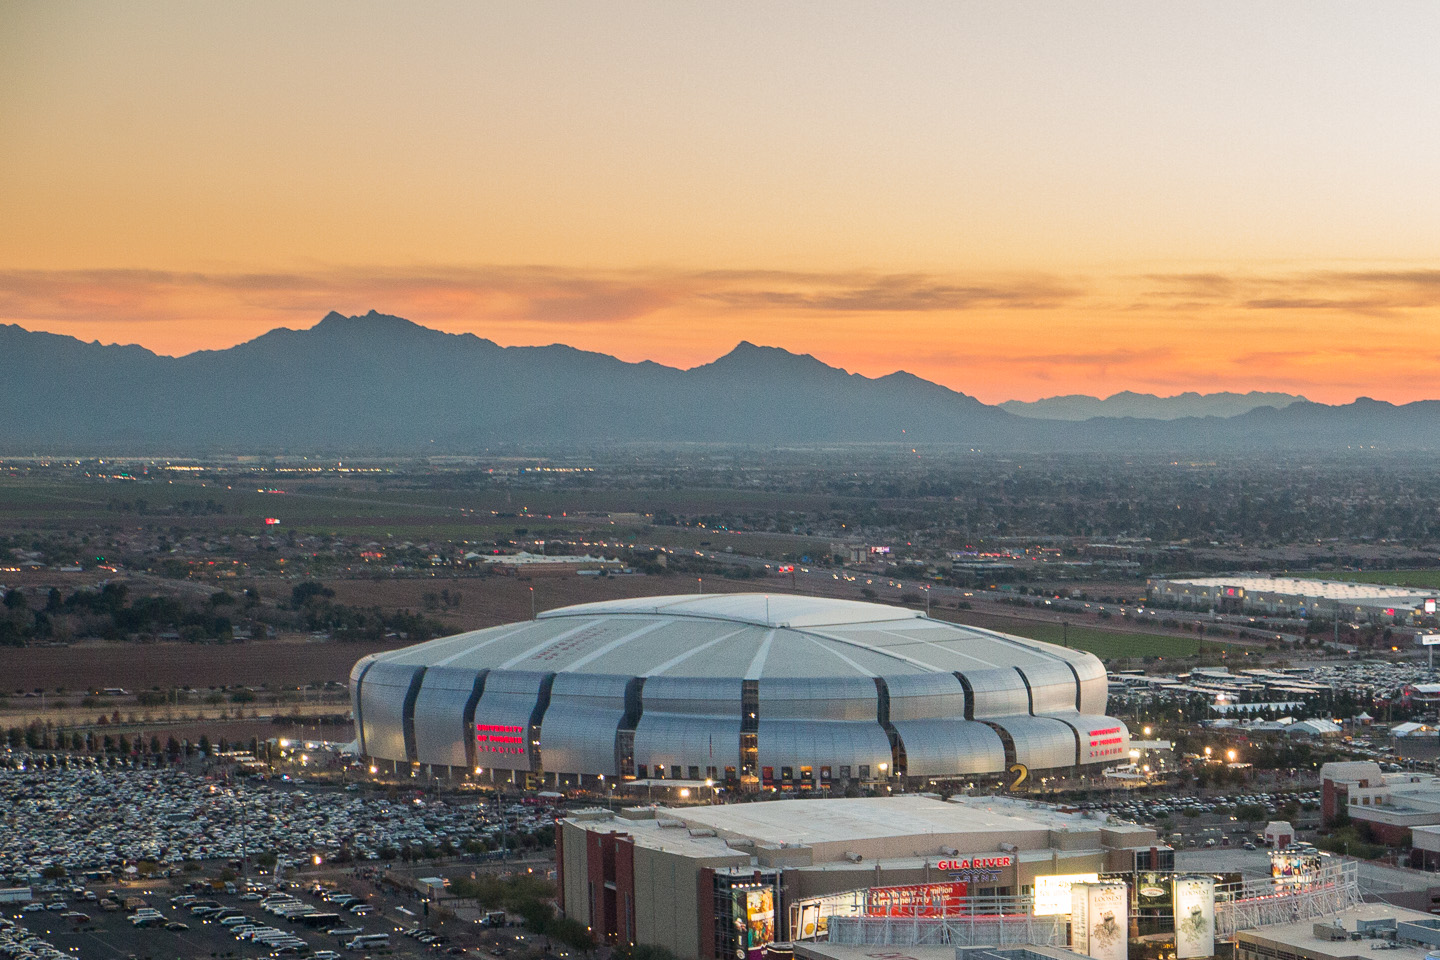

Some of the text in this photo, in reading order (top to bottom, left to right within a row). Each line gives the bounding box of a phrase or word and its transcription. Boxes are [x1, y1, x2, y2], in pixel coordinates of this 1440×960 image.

[476, 724, 523, 733] UNIVERSITY
[478, 745, 524, 754] STADIUM
[1090, 747, 1123, 758] STADIUM
[1009, 763, 1028, 792] 2
[938, 856, 1012, 870] GILA RIVER
[955, 874, 999, 883] ARENA
[930, 886, 953, 895] million
[1094, 895, 1123, 903] LOOSEST
